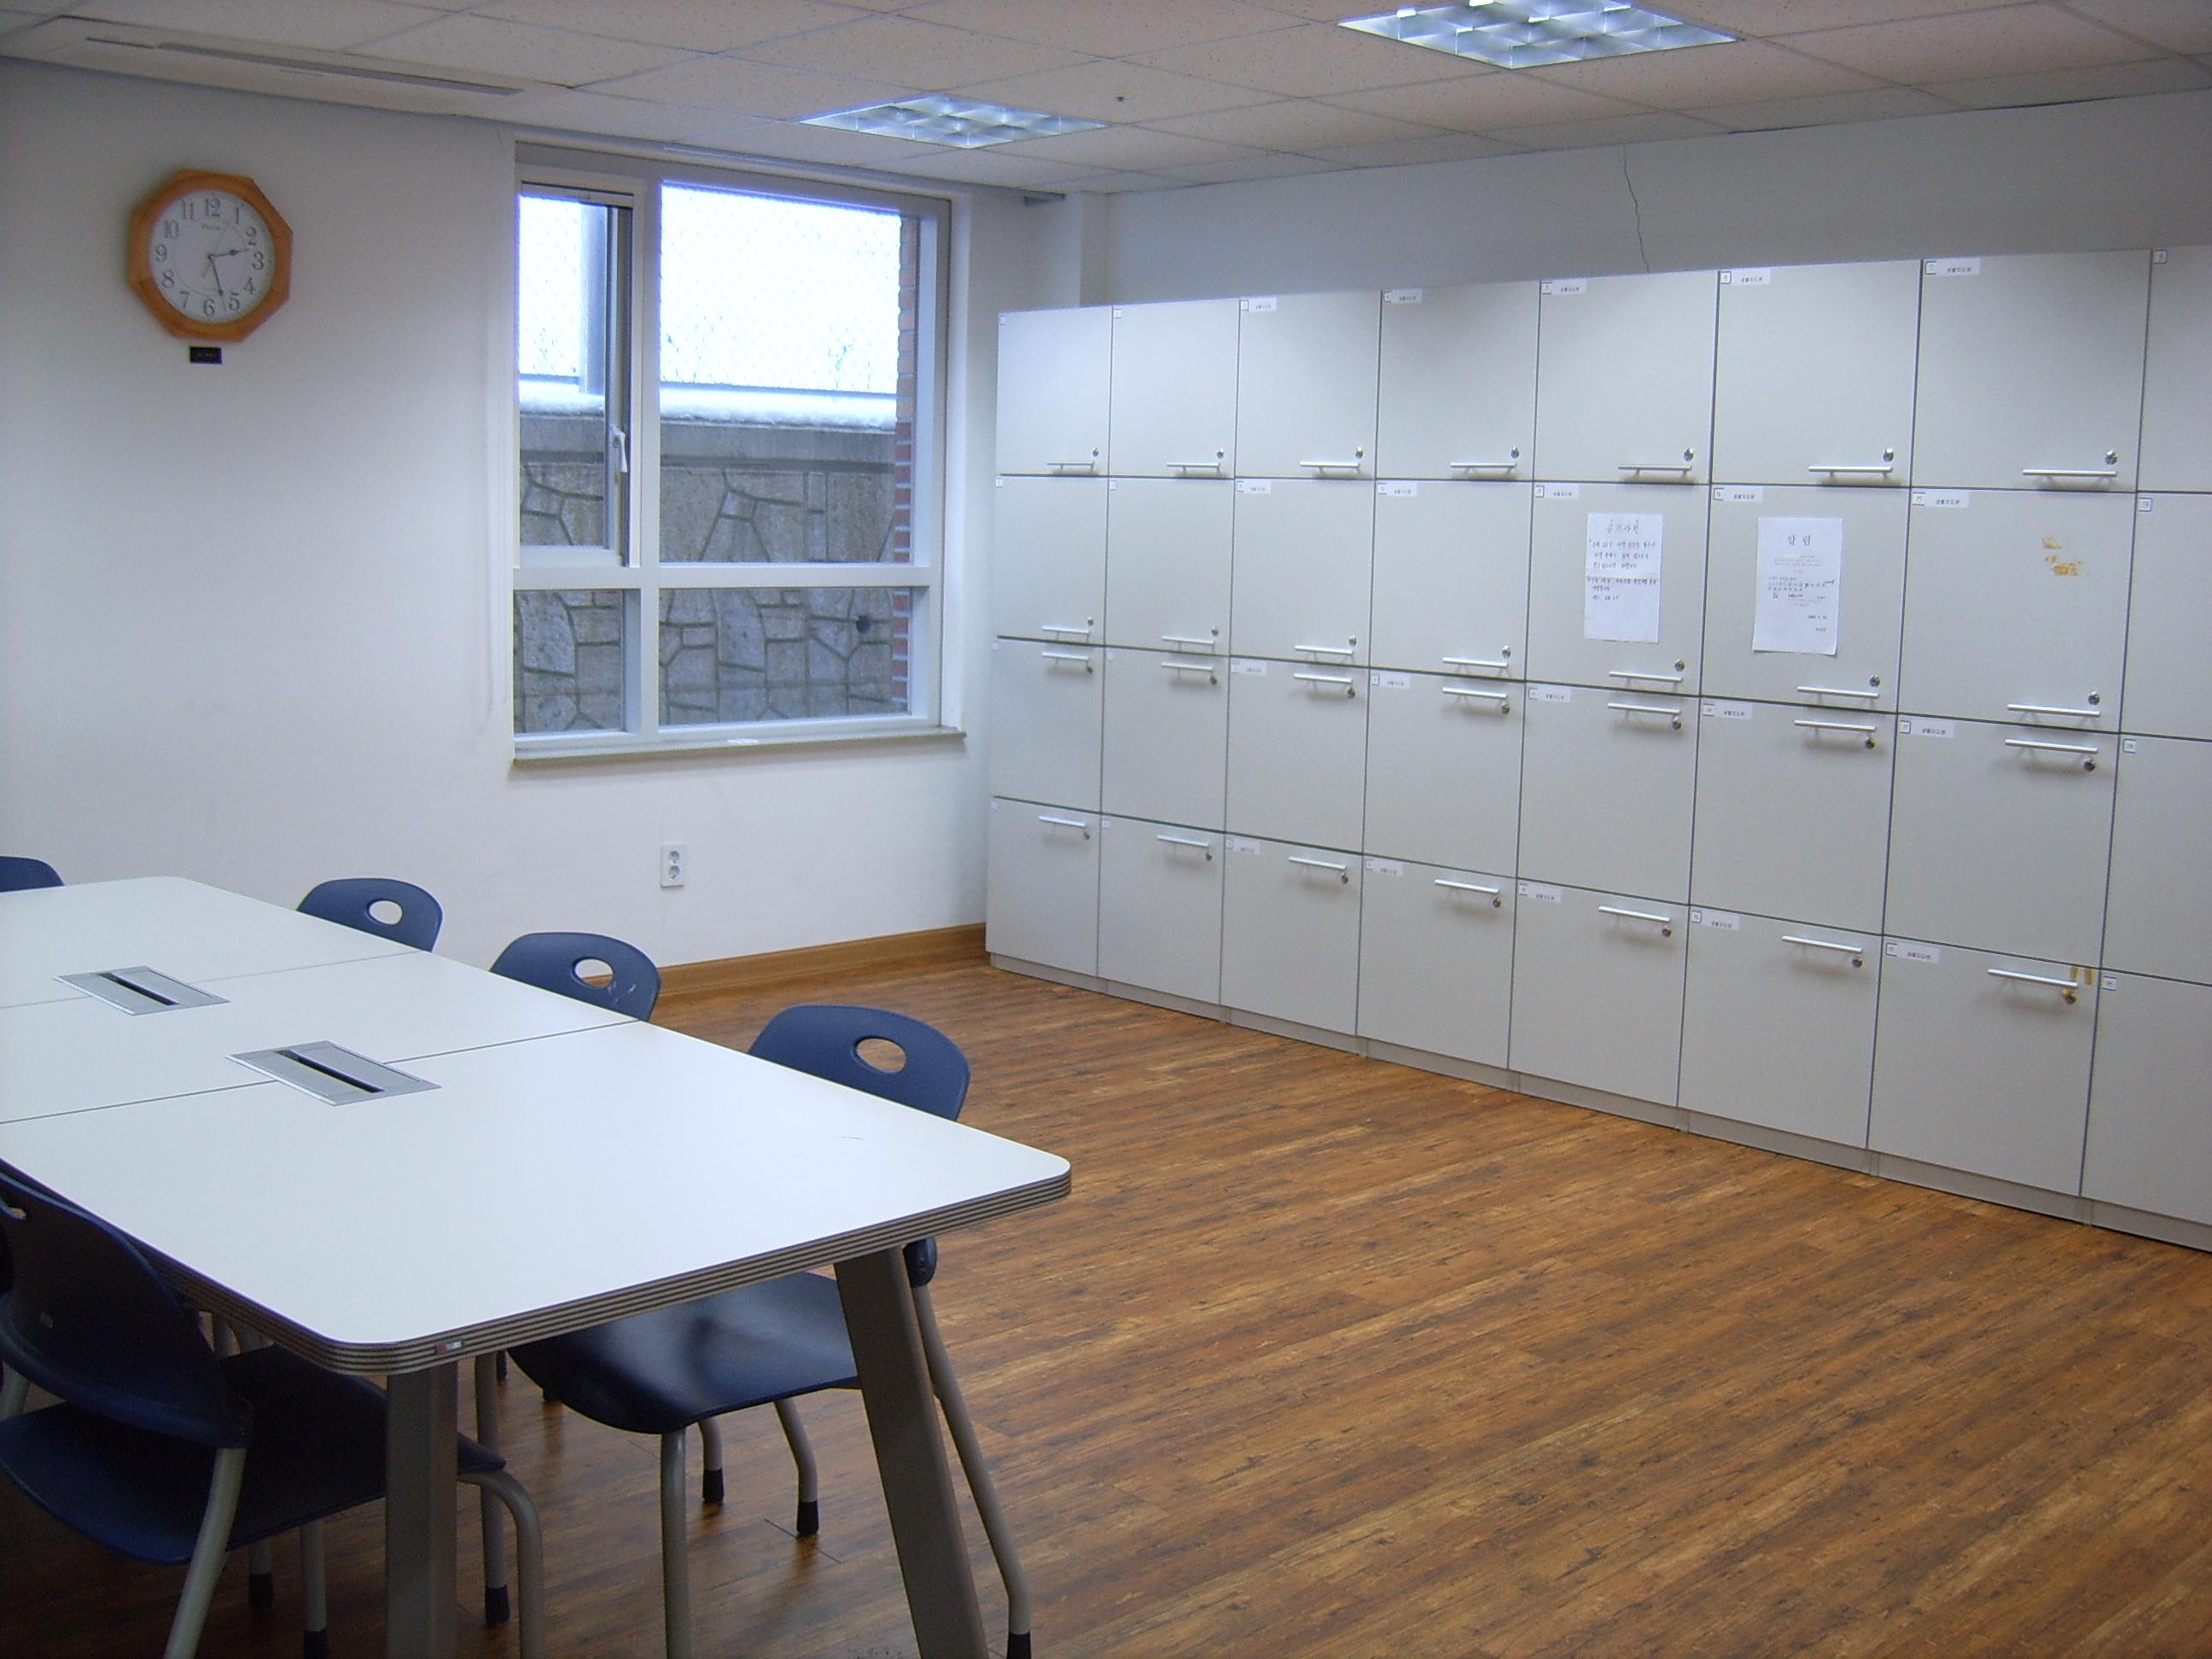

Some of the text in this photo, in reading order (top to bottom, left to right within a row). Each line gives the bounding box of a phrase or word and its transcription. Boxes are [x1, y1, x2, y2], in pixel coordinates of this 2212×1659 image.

[182, 201, 194, 220] 11
[204, 197, 221, 218] 12
[235, 207, 240, 224] 1
[164, 220, 179, 239] 10
[245, 227, 257, 246] 2
[155, 244, 167, 263] 9
[253, 252, 265, 271] 3
[161, 270, 174, 288] 8
[244, 277, 256, 295] 4
[180, 291, 189, 309] 7
[203, 298, 215, 316] 6
[229, 293, 240, 311] 5
